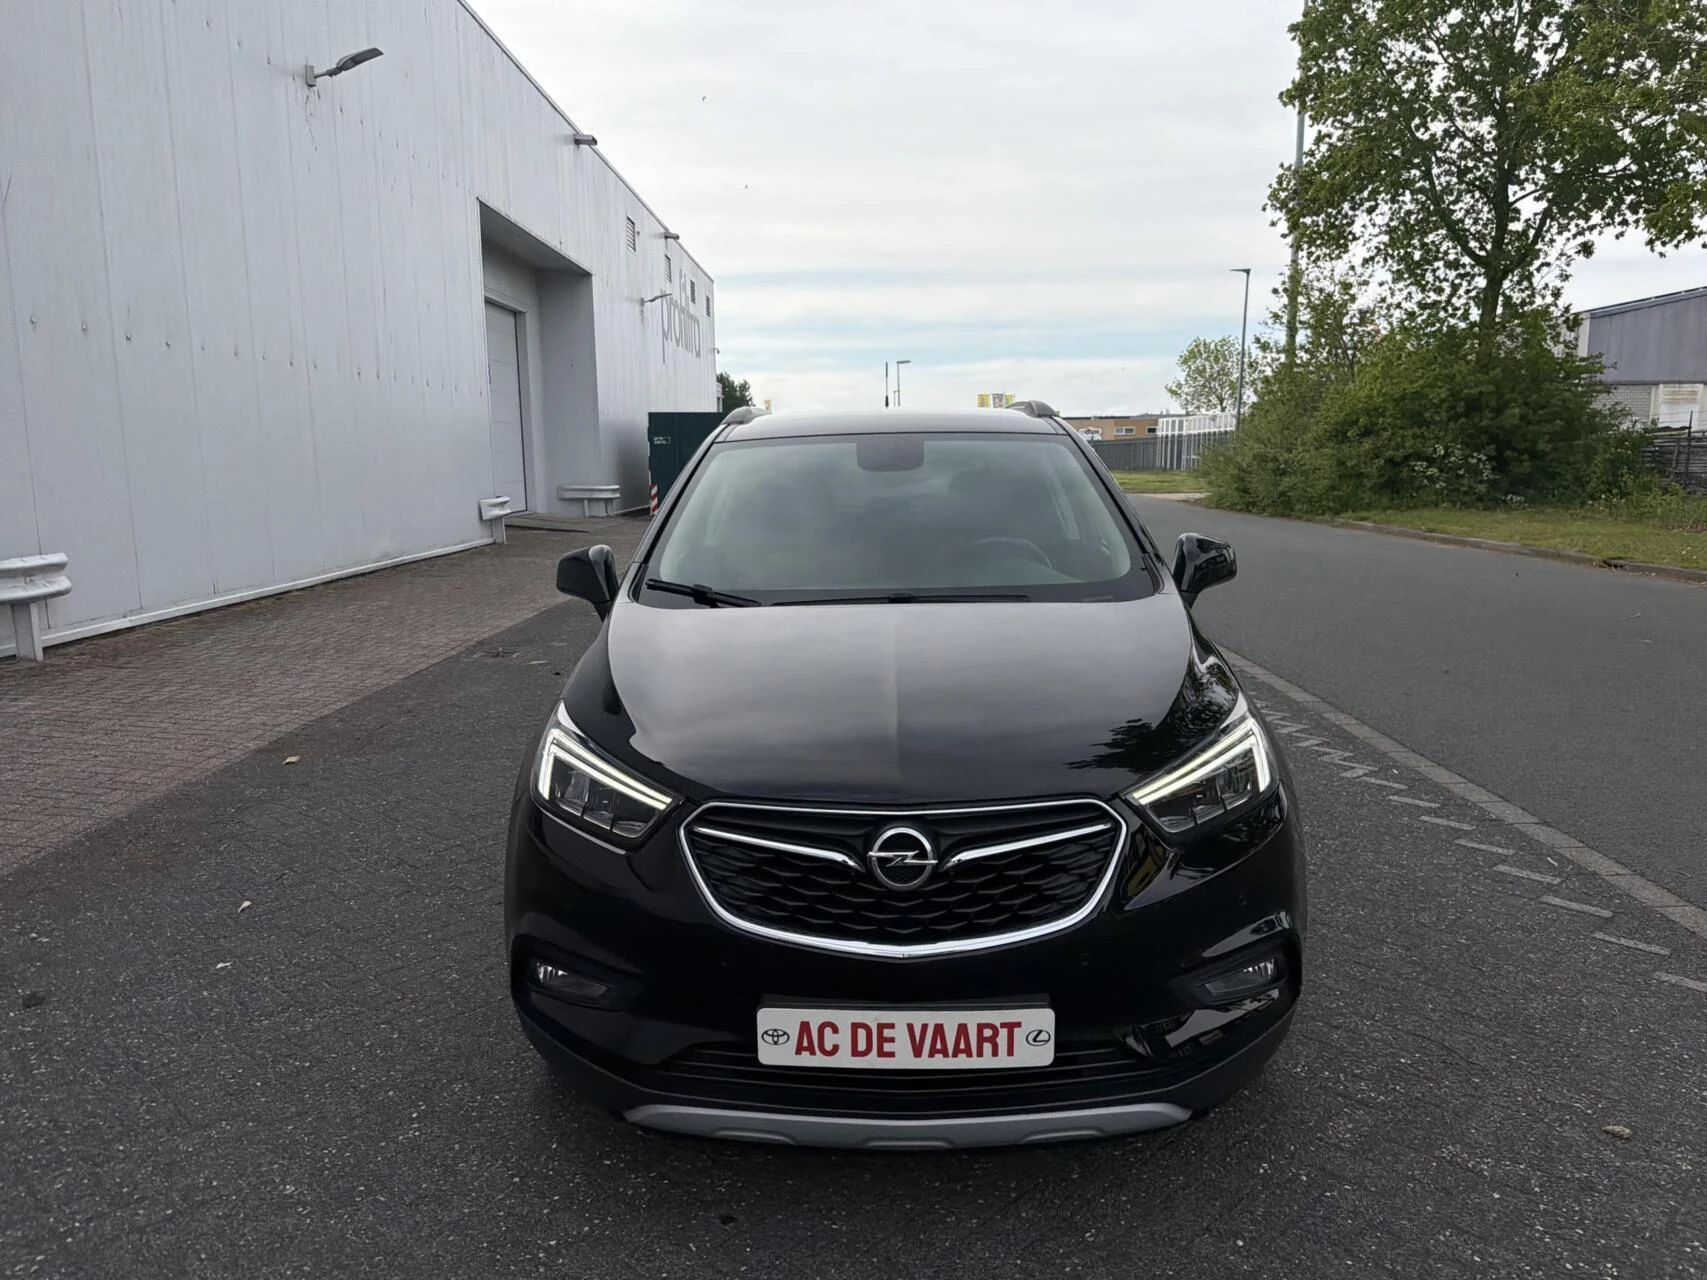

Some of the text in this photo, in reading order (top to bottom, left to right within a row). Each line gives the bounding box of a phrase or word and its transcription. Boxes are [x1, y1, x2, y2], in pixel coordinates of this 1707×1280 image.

[794, 1020, 1022, 1059] AC DE VAART
